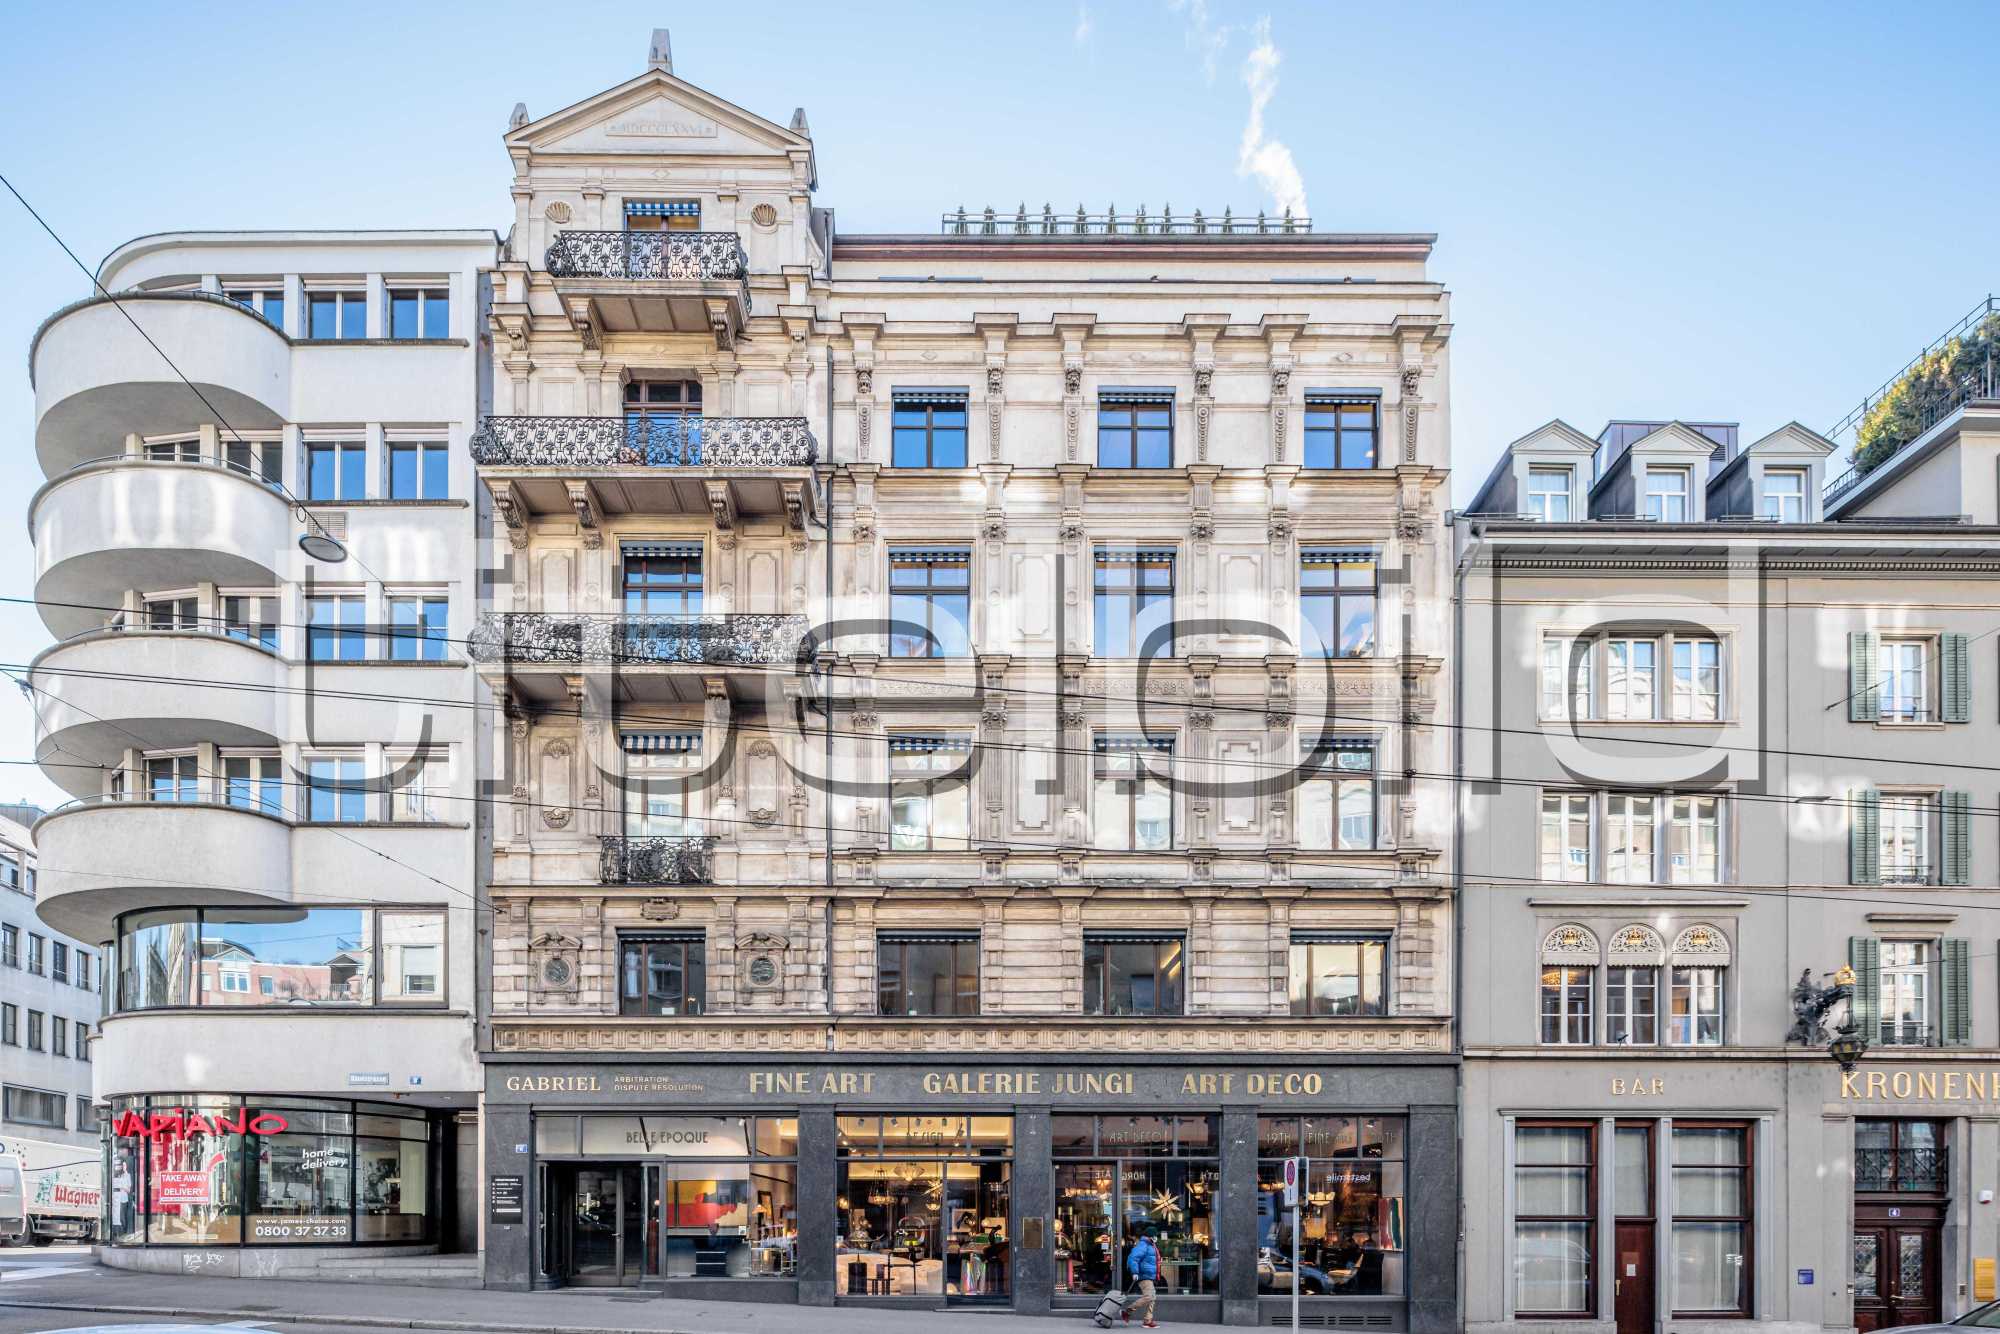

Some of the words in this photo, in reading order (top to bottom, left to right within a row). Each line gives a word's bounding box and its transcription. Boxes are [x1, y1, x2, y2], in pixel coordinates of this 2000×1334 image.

[506, 1076, 601, 1091] GABRIEL
[750, 1072, 811, 1093] FINE
[822, 1072, 876, 1093] ART
[923, 1072, 1041, 1094] GALERIE
[1051, 1072, 1134, 1094] JUNGI
[1180, 1073, 1233, 1094] ART
[1247, 1073, 1322, 1095] DECO
[1612, 1078, 1664, 1095] BAR
[112, 1107, 289, 1142] VAPIANO
[626, 1131, 656, 1143] BELLE
[660, 1131, 708, 1144] EPOQUE
[302, 1148, 334, 1159] home
[302, 1158, 347, 1169] delivery
[161, 1174, 182, 1182] TAKE
[184, 1174, 207, 1182] AWAY
[55, 1185, 100, 1207] Wagner
[164, 1188, 204, 1196] DELIVERY
[255, 1226, 291, 1237] 0800
[294, 1226, 311, 1237] 37
[313, 1226, 330, 1237] 37
[331, 1226, 347, 1237] 33
